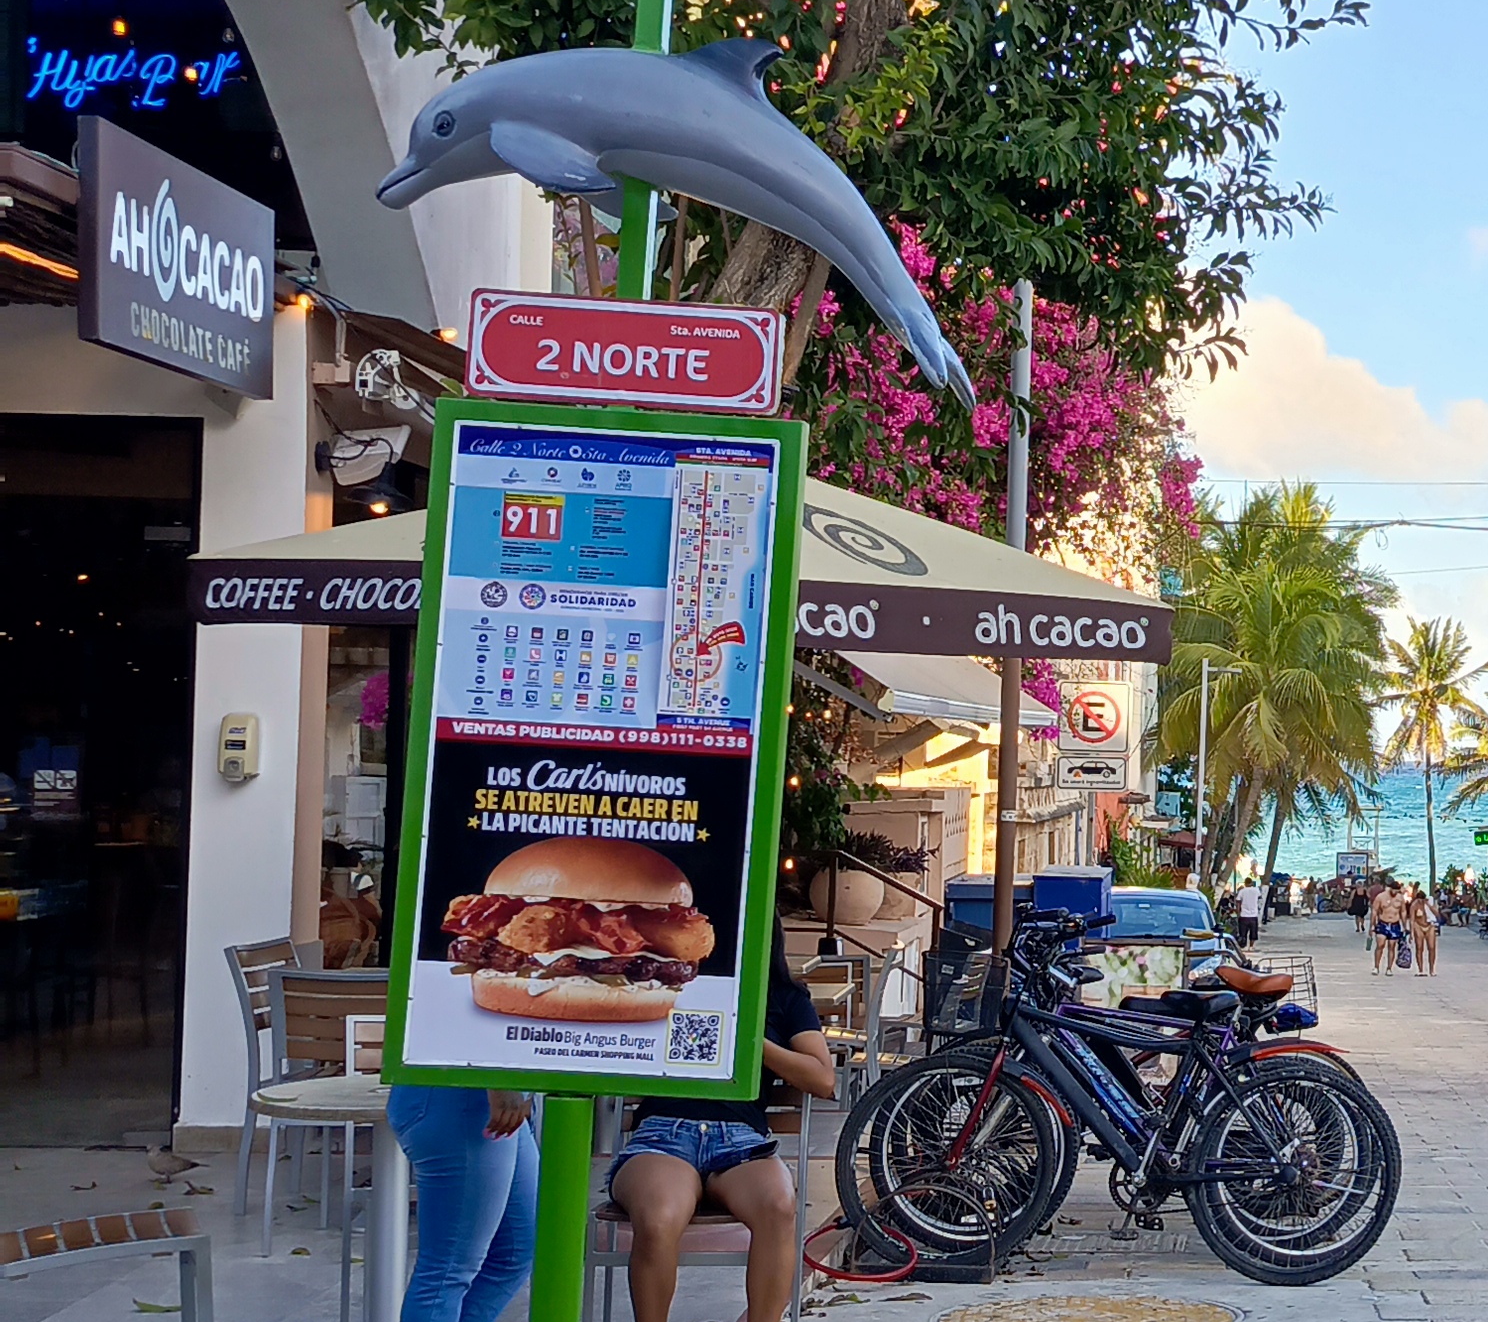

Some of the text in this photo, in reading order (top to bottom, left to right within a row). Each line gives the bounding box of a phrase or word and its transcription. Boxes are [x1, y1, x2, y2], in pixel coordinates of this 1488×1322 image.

[179, 224, 263, 323] CACAO
[130, 301, 213, 364] CHOCOLATE
[509, 313, 544, 327] CALLE
[692, 326, 740, 340] AVENIDA
[535, 338, 710, 381] 2 NORTE
[470, 438, 505, 454] Calle
[508, 442, 522, 456] 2
[524, 442, 566, 459] Norte
[506, 505, 558, 535] 911
[205, 577, 422, 611] COFFEE CHOCO
[550, 593, 637, 608] SOLIDARIDAD
[974, 604, 1147, 649] ah cacao
[452, 721, 517, 737] VENTAS
[519, 725, 615, 742] PUBLICIDAD
[486, 766, 522, 787] LOS
[474, 788, 699, 821] SE ATREVEN A CAER EN
[481, 811, 695, 843] LA PICANTE TENTACIÓN
[506, 1025, 657, 1050] El Diablo Big Angus Burger
[534, 1047, 556, 1056] PASEO
[557, 1048, 570, 1057] DEL
